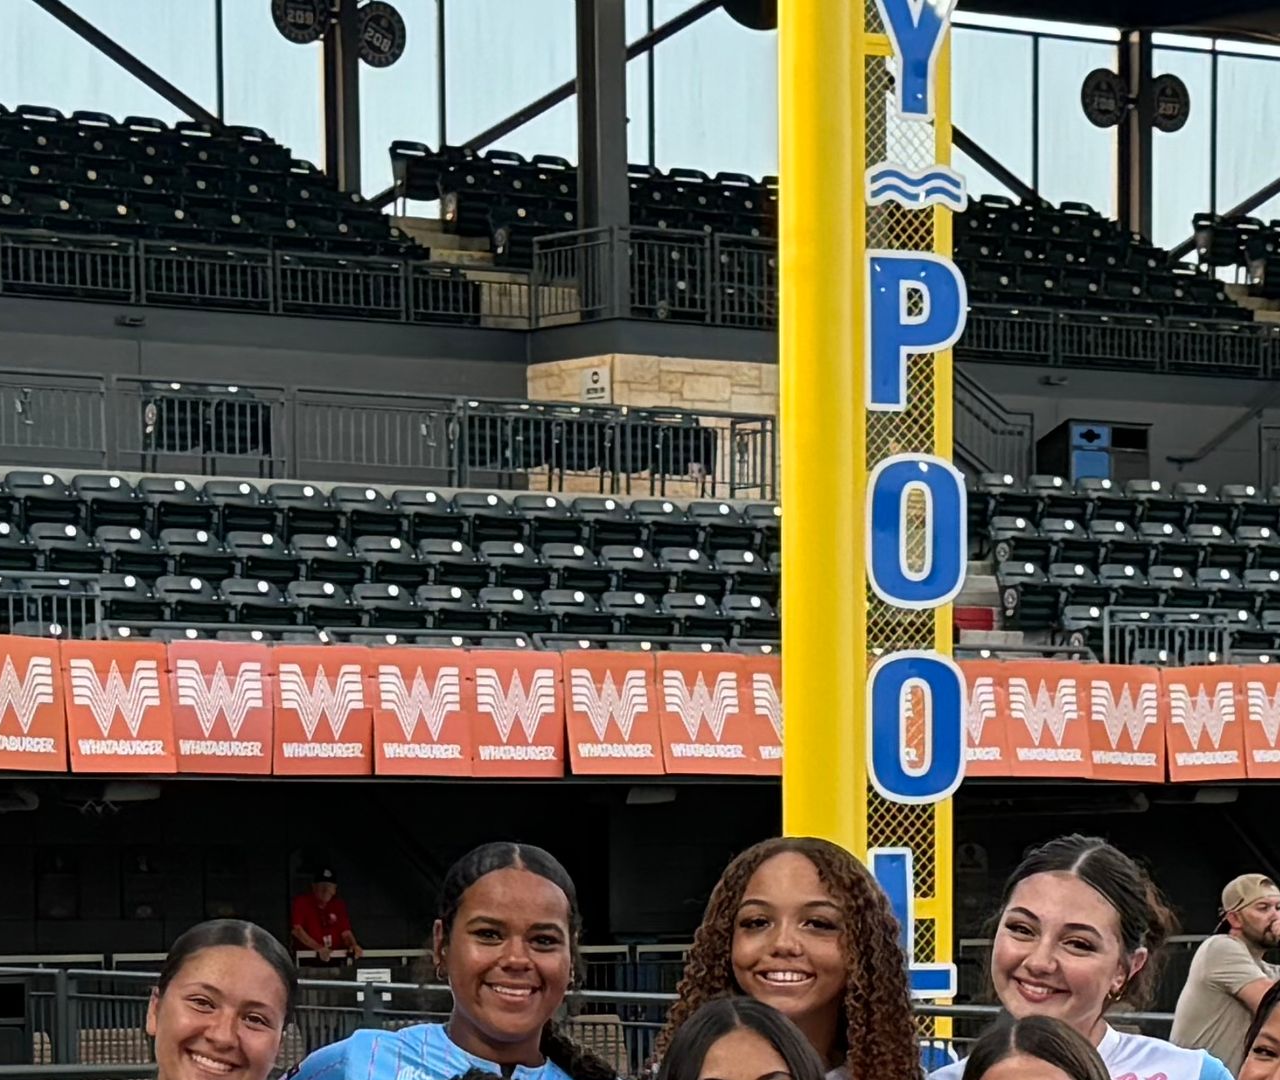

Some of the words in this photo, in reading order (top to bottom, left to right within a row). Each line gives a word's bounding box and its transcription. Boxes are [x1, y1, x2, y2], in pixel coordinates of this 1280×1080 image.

[865, 250, 968, 1072] POOL
[78, 739, 167, 756] WHATABURGER
[179, 740, 265, 757] WHATABURGER
[283, 743, 364, 758] WHATABURGER
[383, 743, 464, 759] WHATABURGER
[479, 745, 558, 760] WHATABURGER
